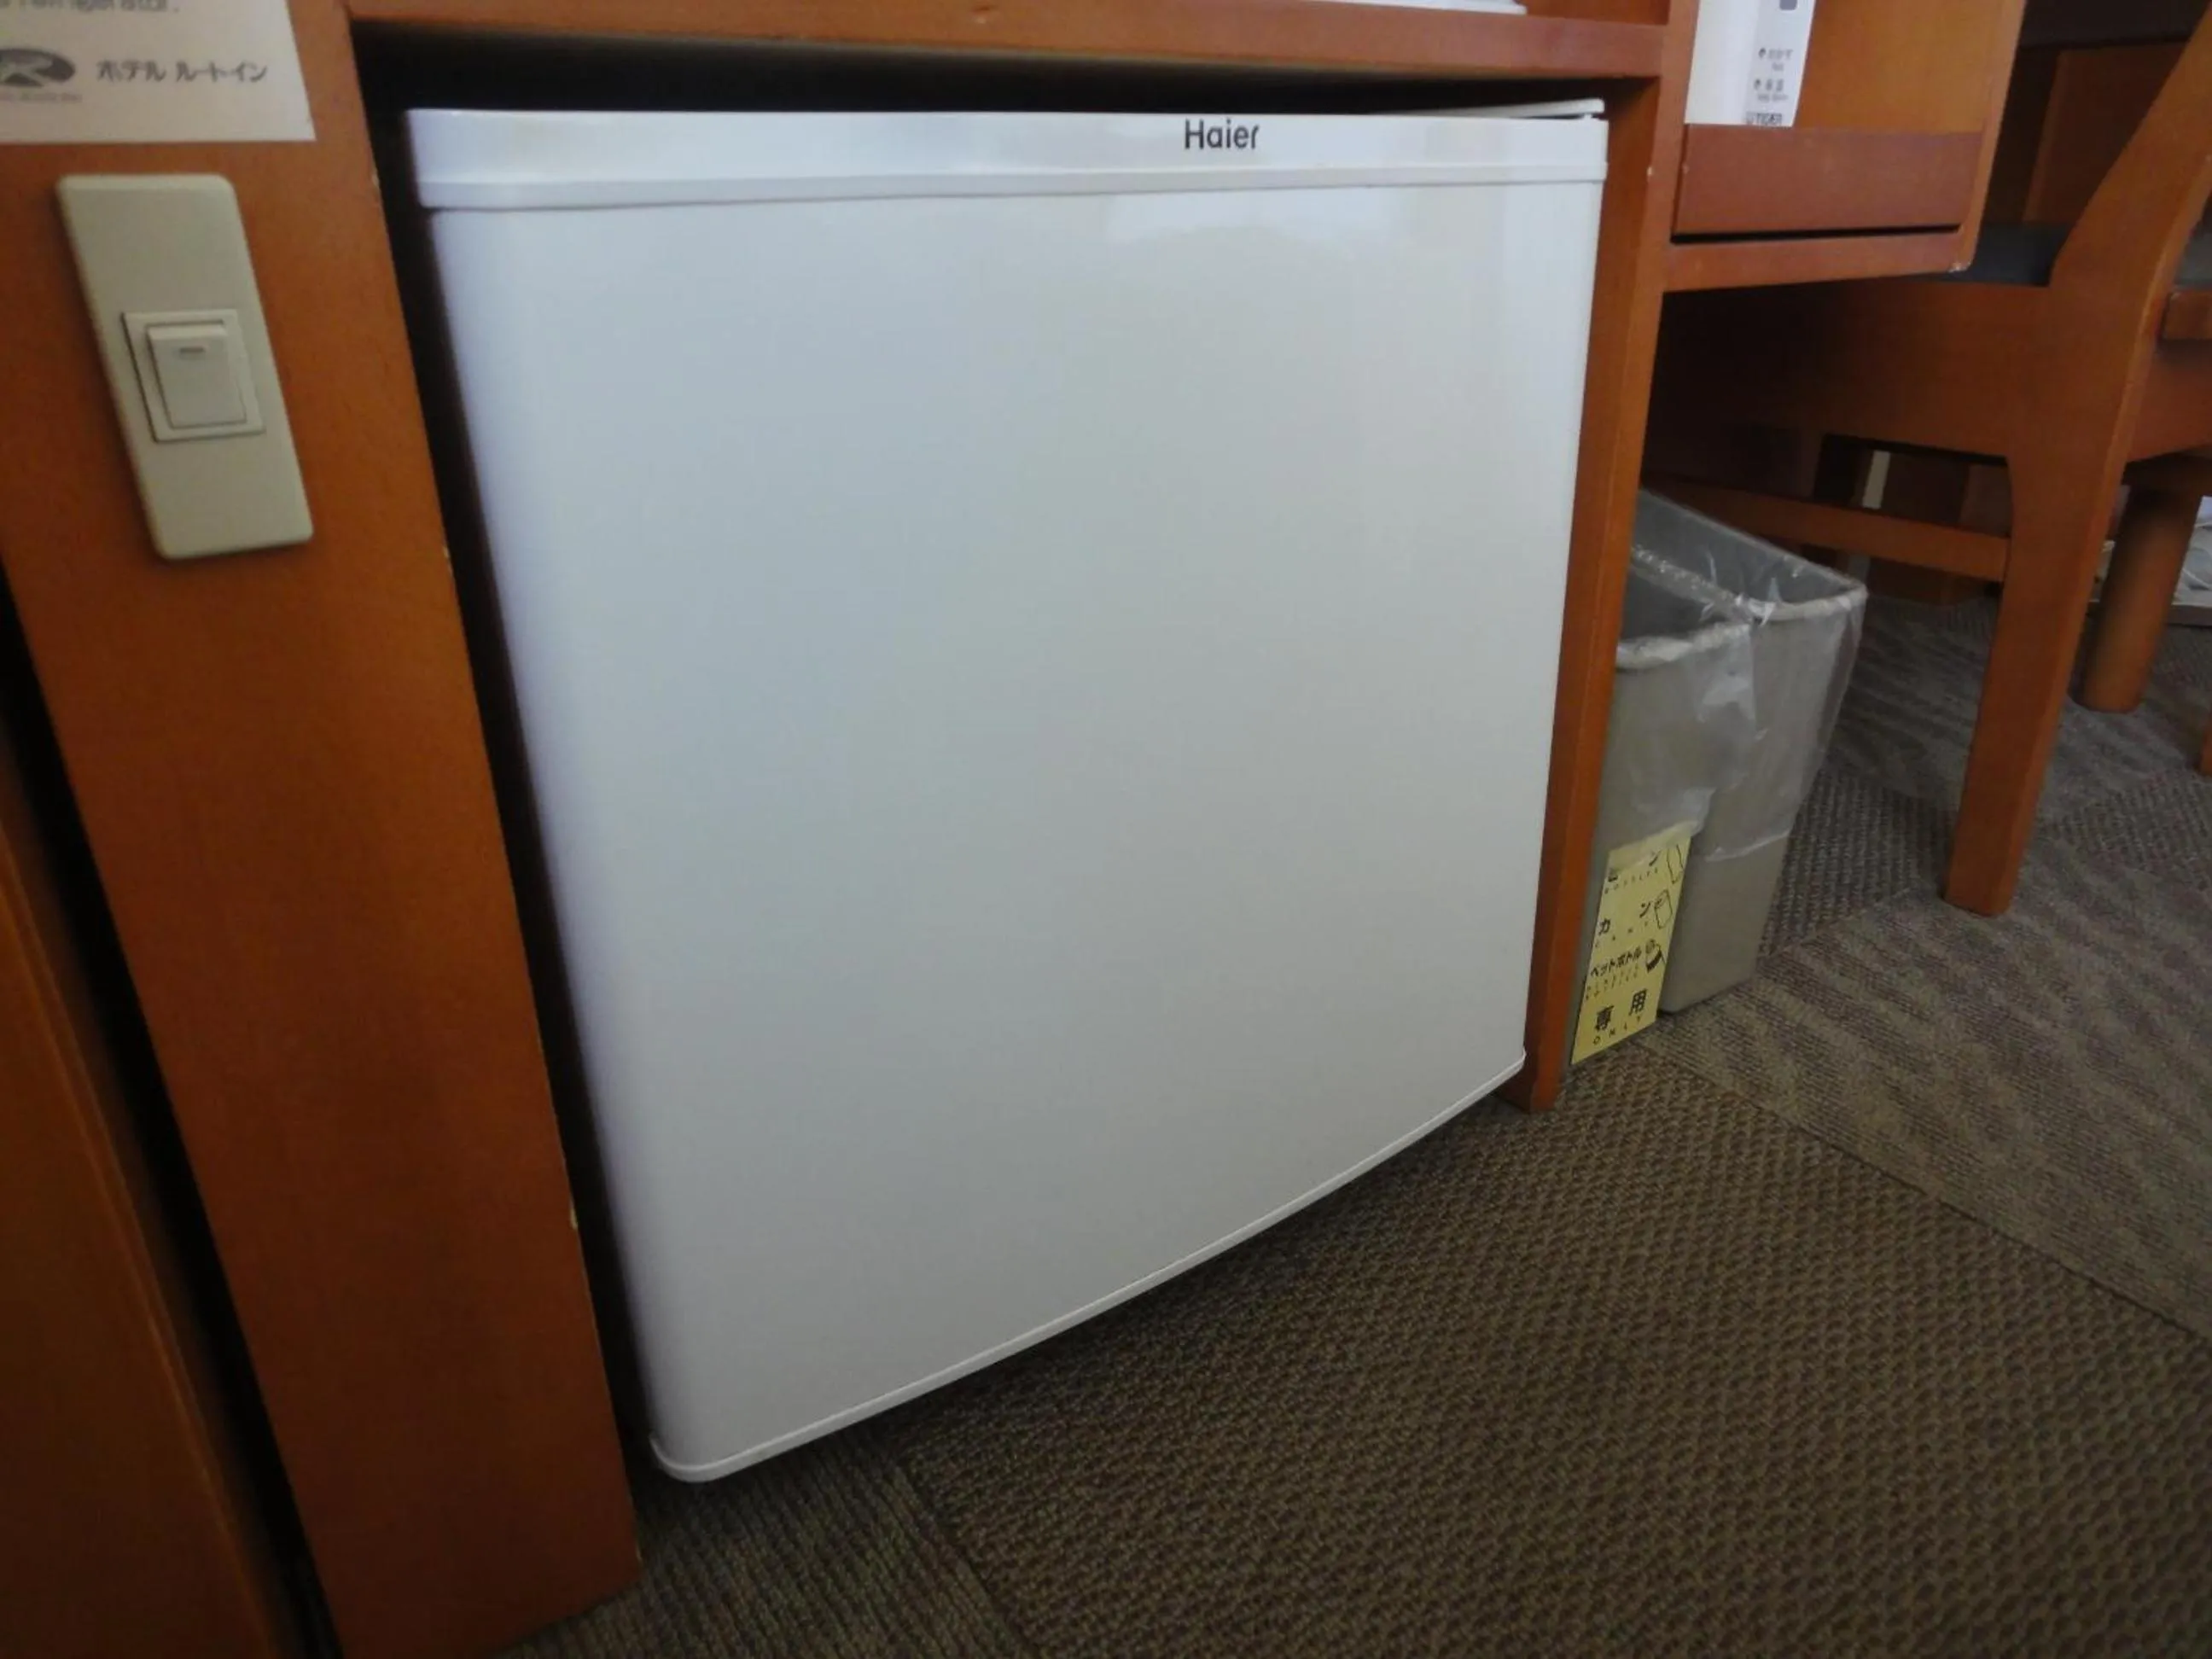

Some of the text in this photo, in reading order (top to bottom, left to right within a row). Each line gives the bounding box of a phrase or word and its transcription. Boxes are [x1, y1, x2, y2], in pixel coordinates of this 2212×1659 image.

[96, 60, 267, 83] ホテル ルートイン
[1185, 118, 1260, 150] Haier
